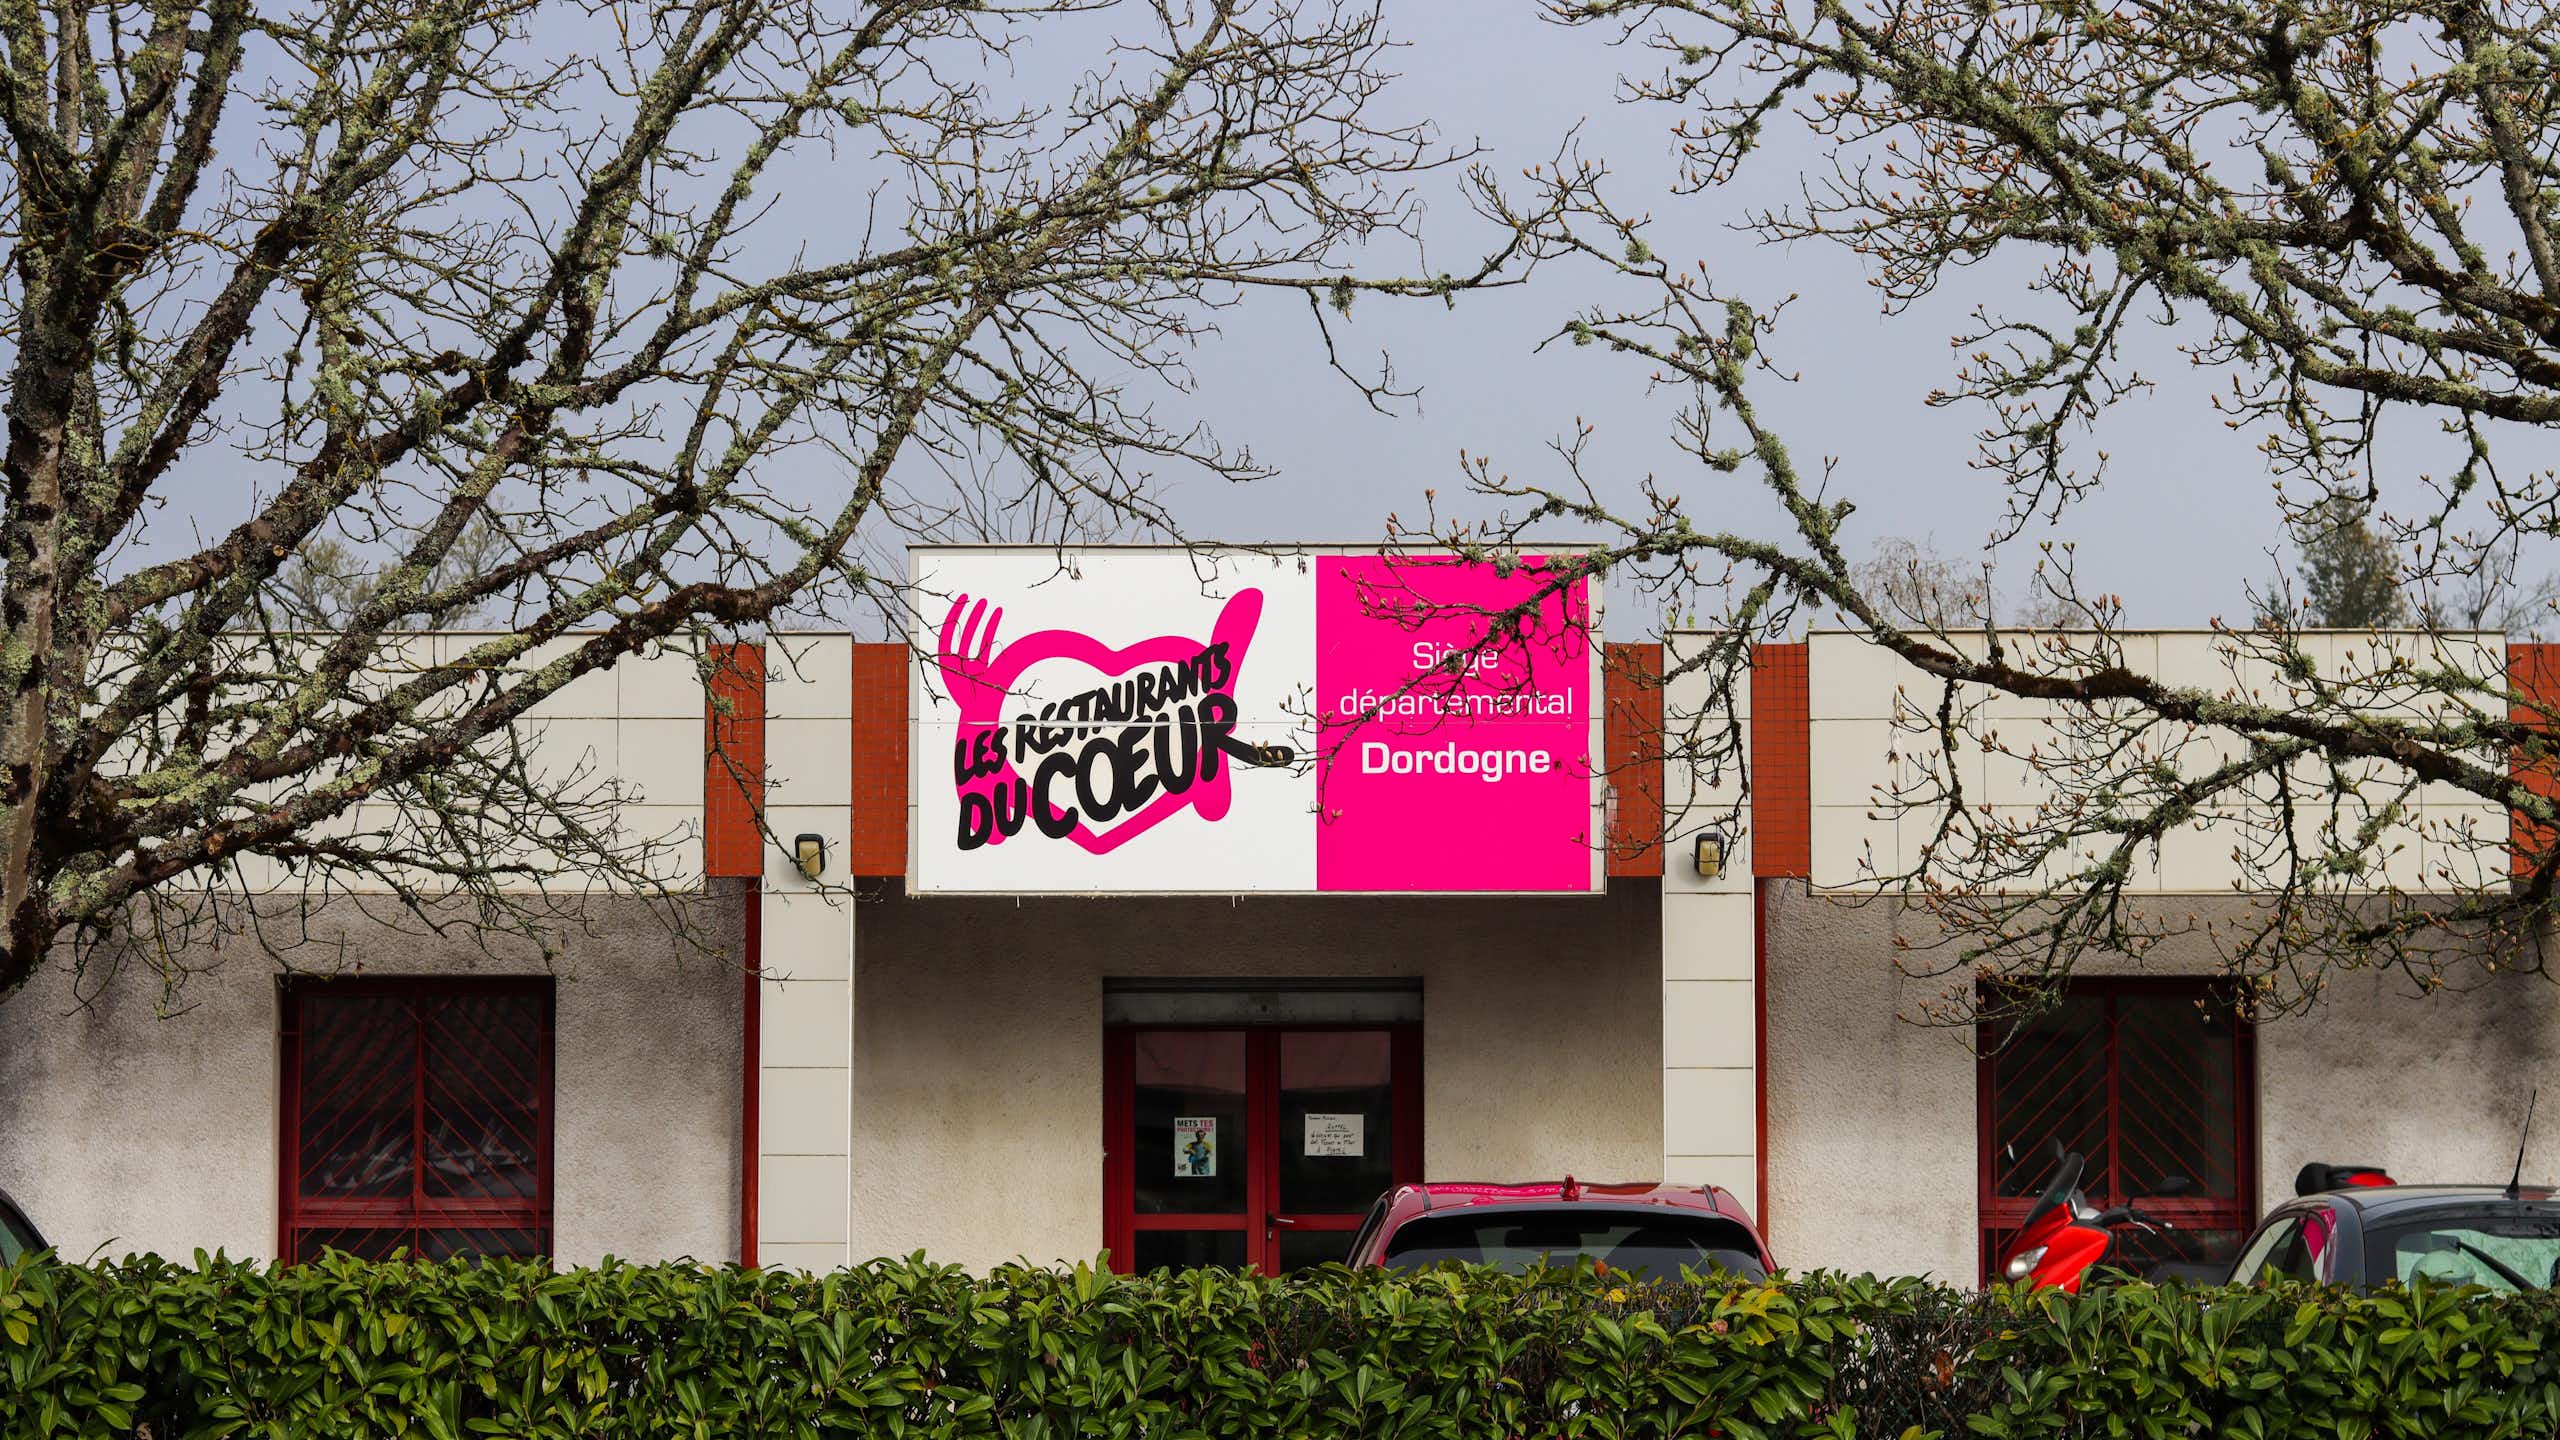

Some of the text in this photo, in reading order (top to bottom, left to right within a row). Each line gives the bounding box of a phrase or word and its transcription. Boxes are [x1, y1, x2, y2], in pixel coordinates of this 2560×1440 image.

[954, 641, 1231, 786] LES RESTAURANTS
[1340, 687, 1572, 722] départemental
[957, 693, 1295, 851] DU COEUR
[1361, 741, 1550, 783] Dordogne
